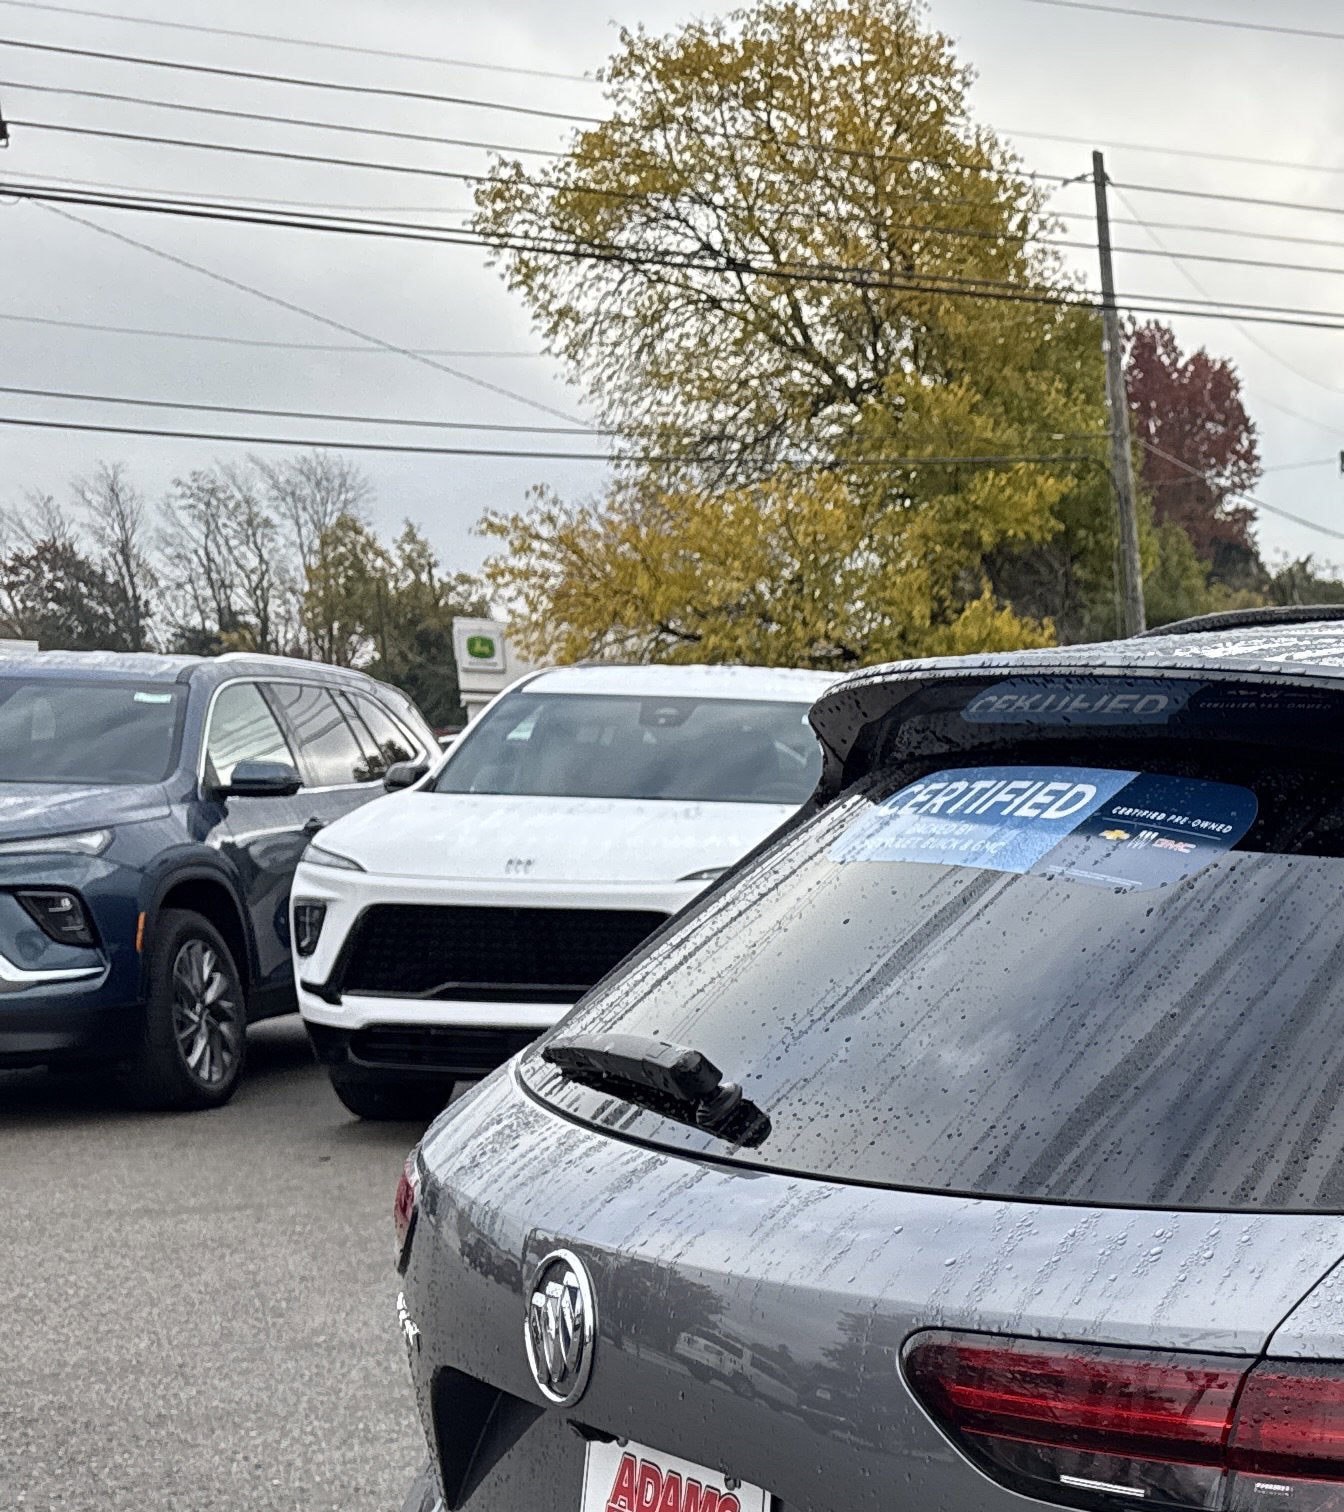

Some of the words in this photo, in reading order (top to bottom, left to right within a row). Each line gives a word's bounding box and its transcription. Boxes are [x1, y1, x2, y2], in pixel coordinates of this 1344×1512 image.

[877, 779, 1098, 820] CERTIFIED
[1111, 805, 1168, 822] CERTIFIED
[1166, 814, 1233, 834] PRE-OWNED
[1152, 837, 1197, 854] GMC
